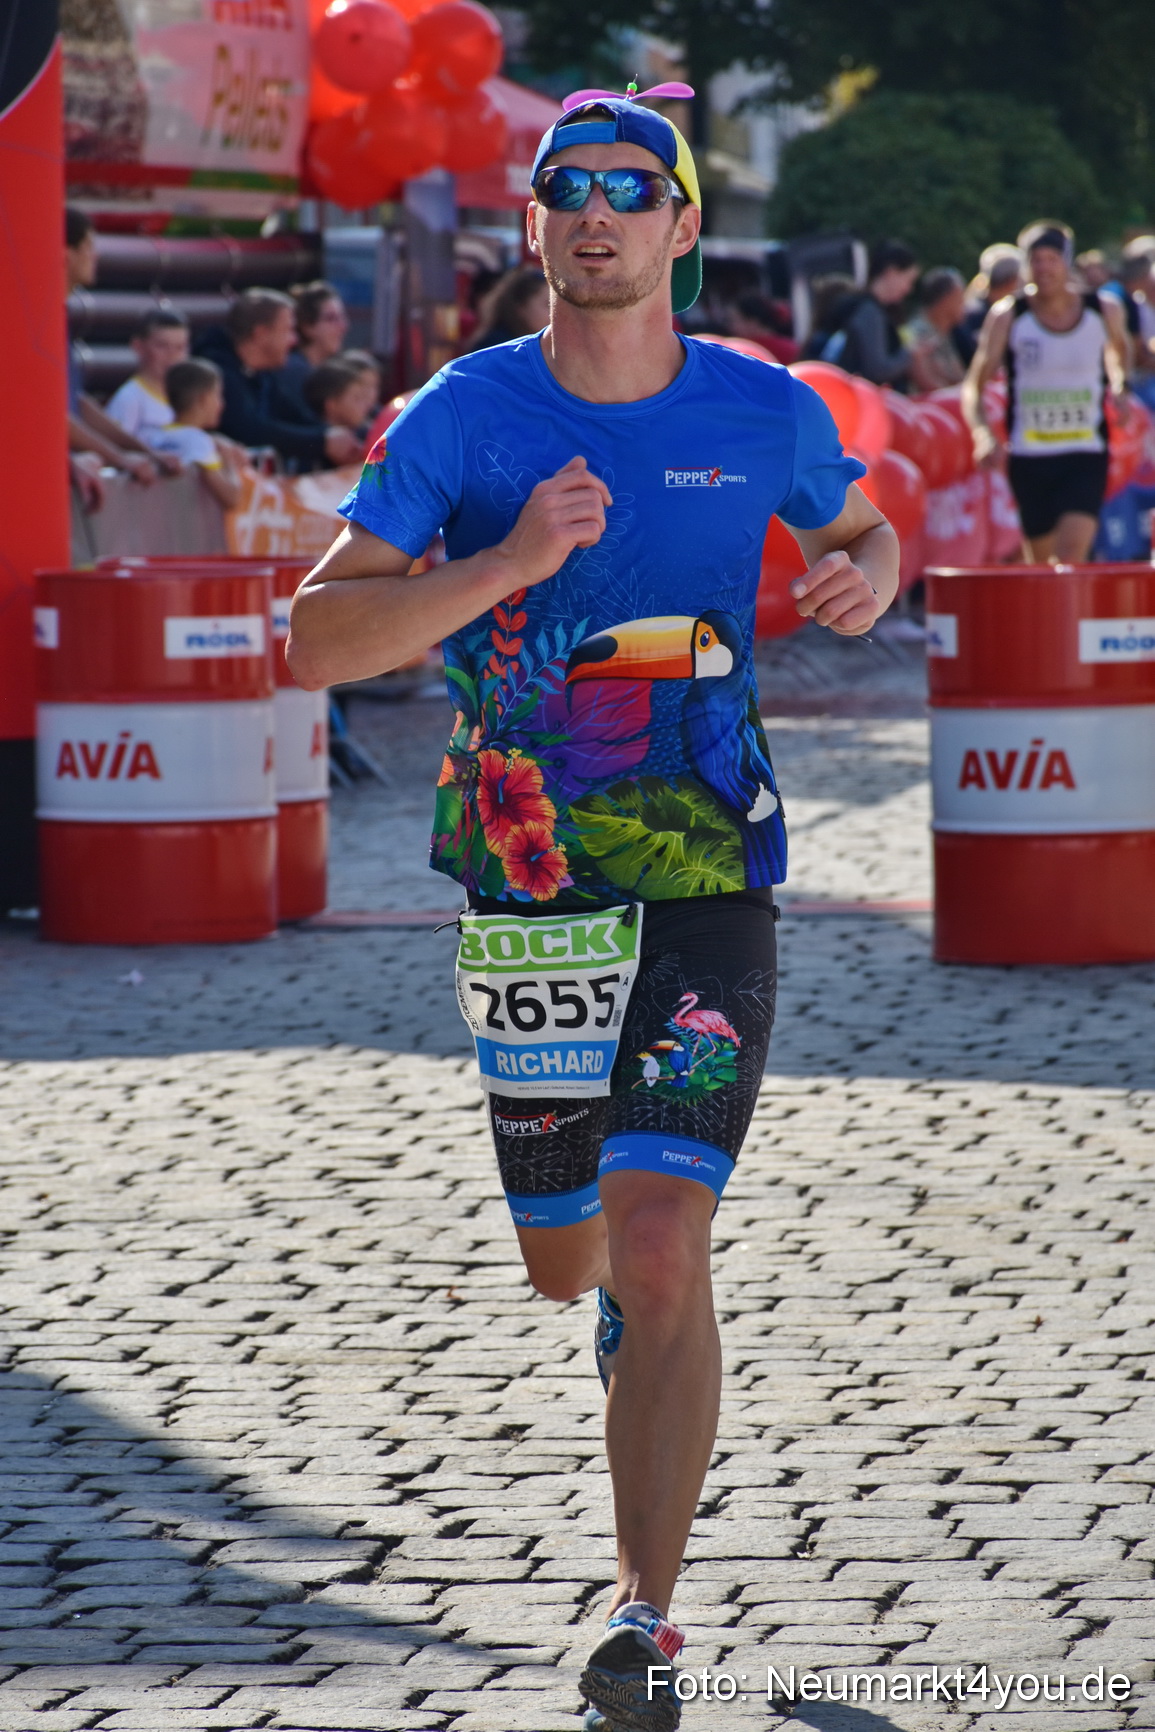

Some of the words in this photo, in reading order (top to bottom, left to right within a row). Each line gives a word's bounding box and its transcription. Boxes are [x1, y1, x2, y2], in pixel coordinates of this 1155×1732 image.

[719, 474, 748, 483] SPORTS
[469, 973, 620, 1032] 2655
[496, 1050, 604, 1075] RICHARD
[555, 1108, 590, 1127] SPORTS
[698, 1160, 717, 1172] SPORTS
